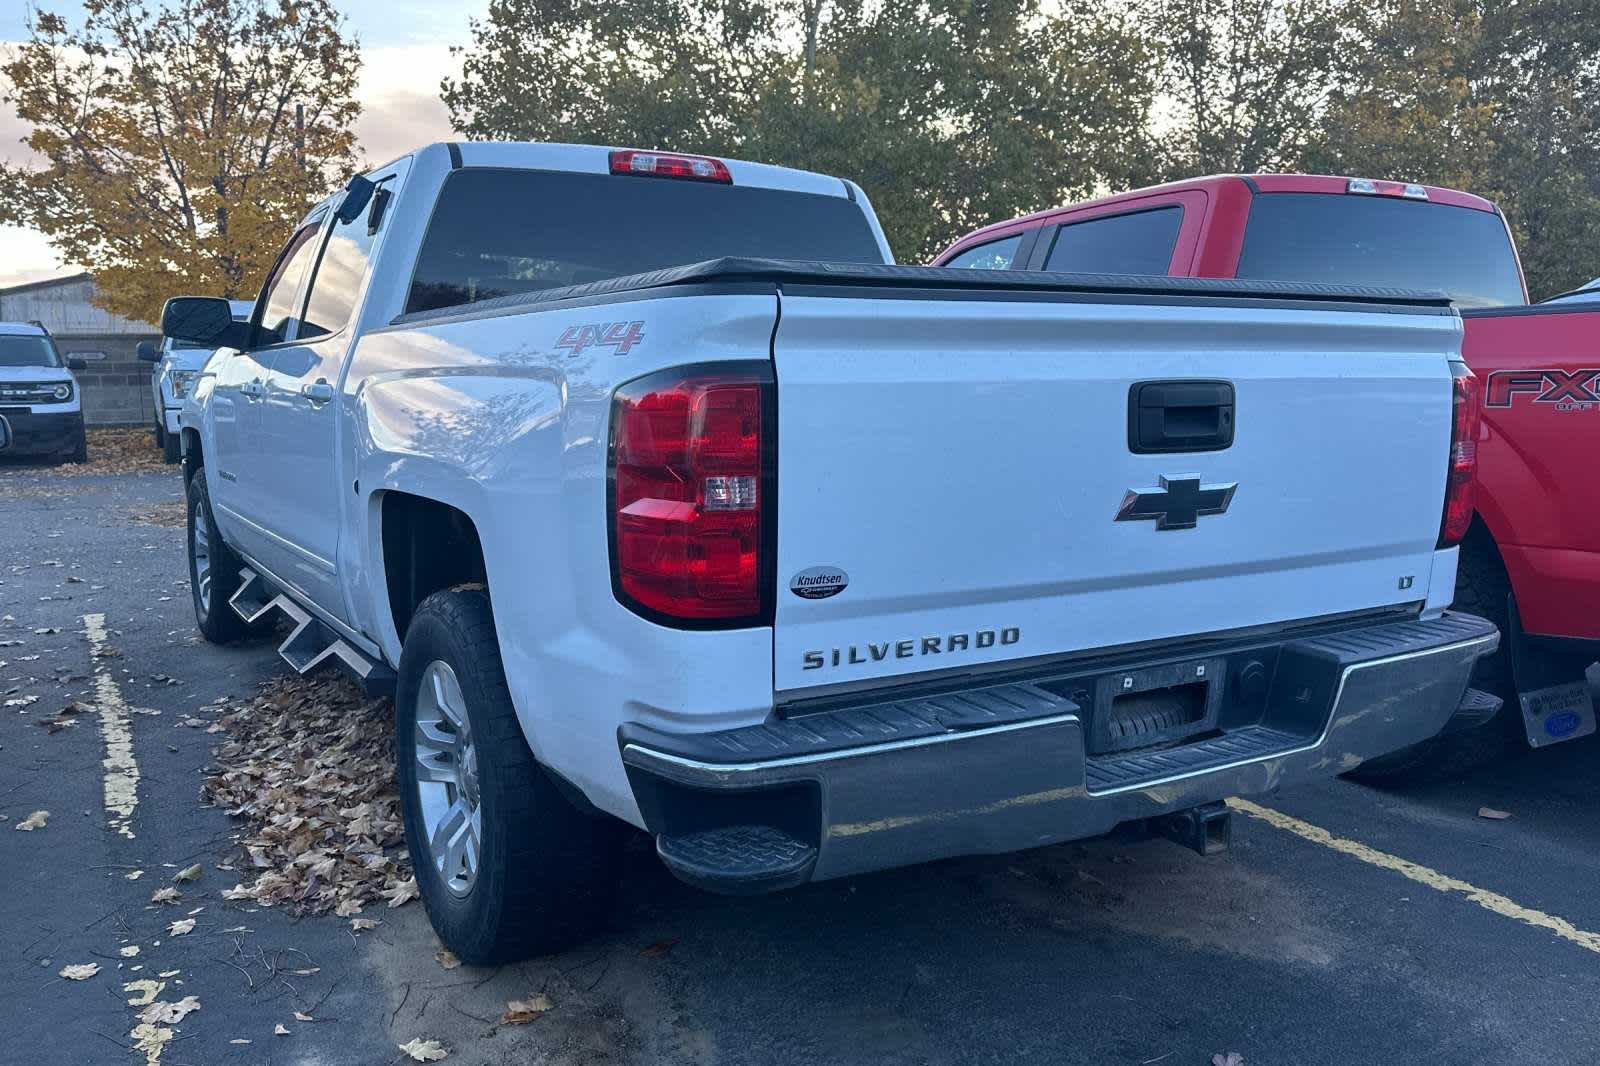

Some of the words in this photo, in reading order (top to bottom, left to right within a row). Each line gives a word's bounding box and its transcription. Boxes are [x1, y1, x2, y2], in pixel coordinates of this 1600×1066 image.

[1485, 368, 1600, 408] FX
[797, 574, 842, 586] Knudtsen
[1398, 575, 1415, 590] LT
[802, 627, 1020, 670] SILVERADO
